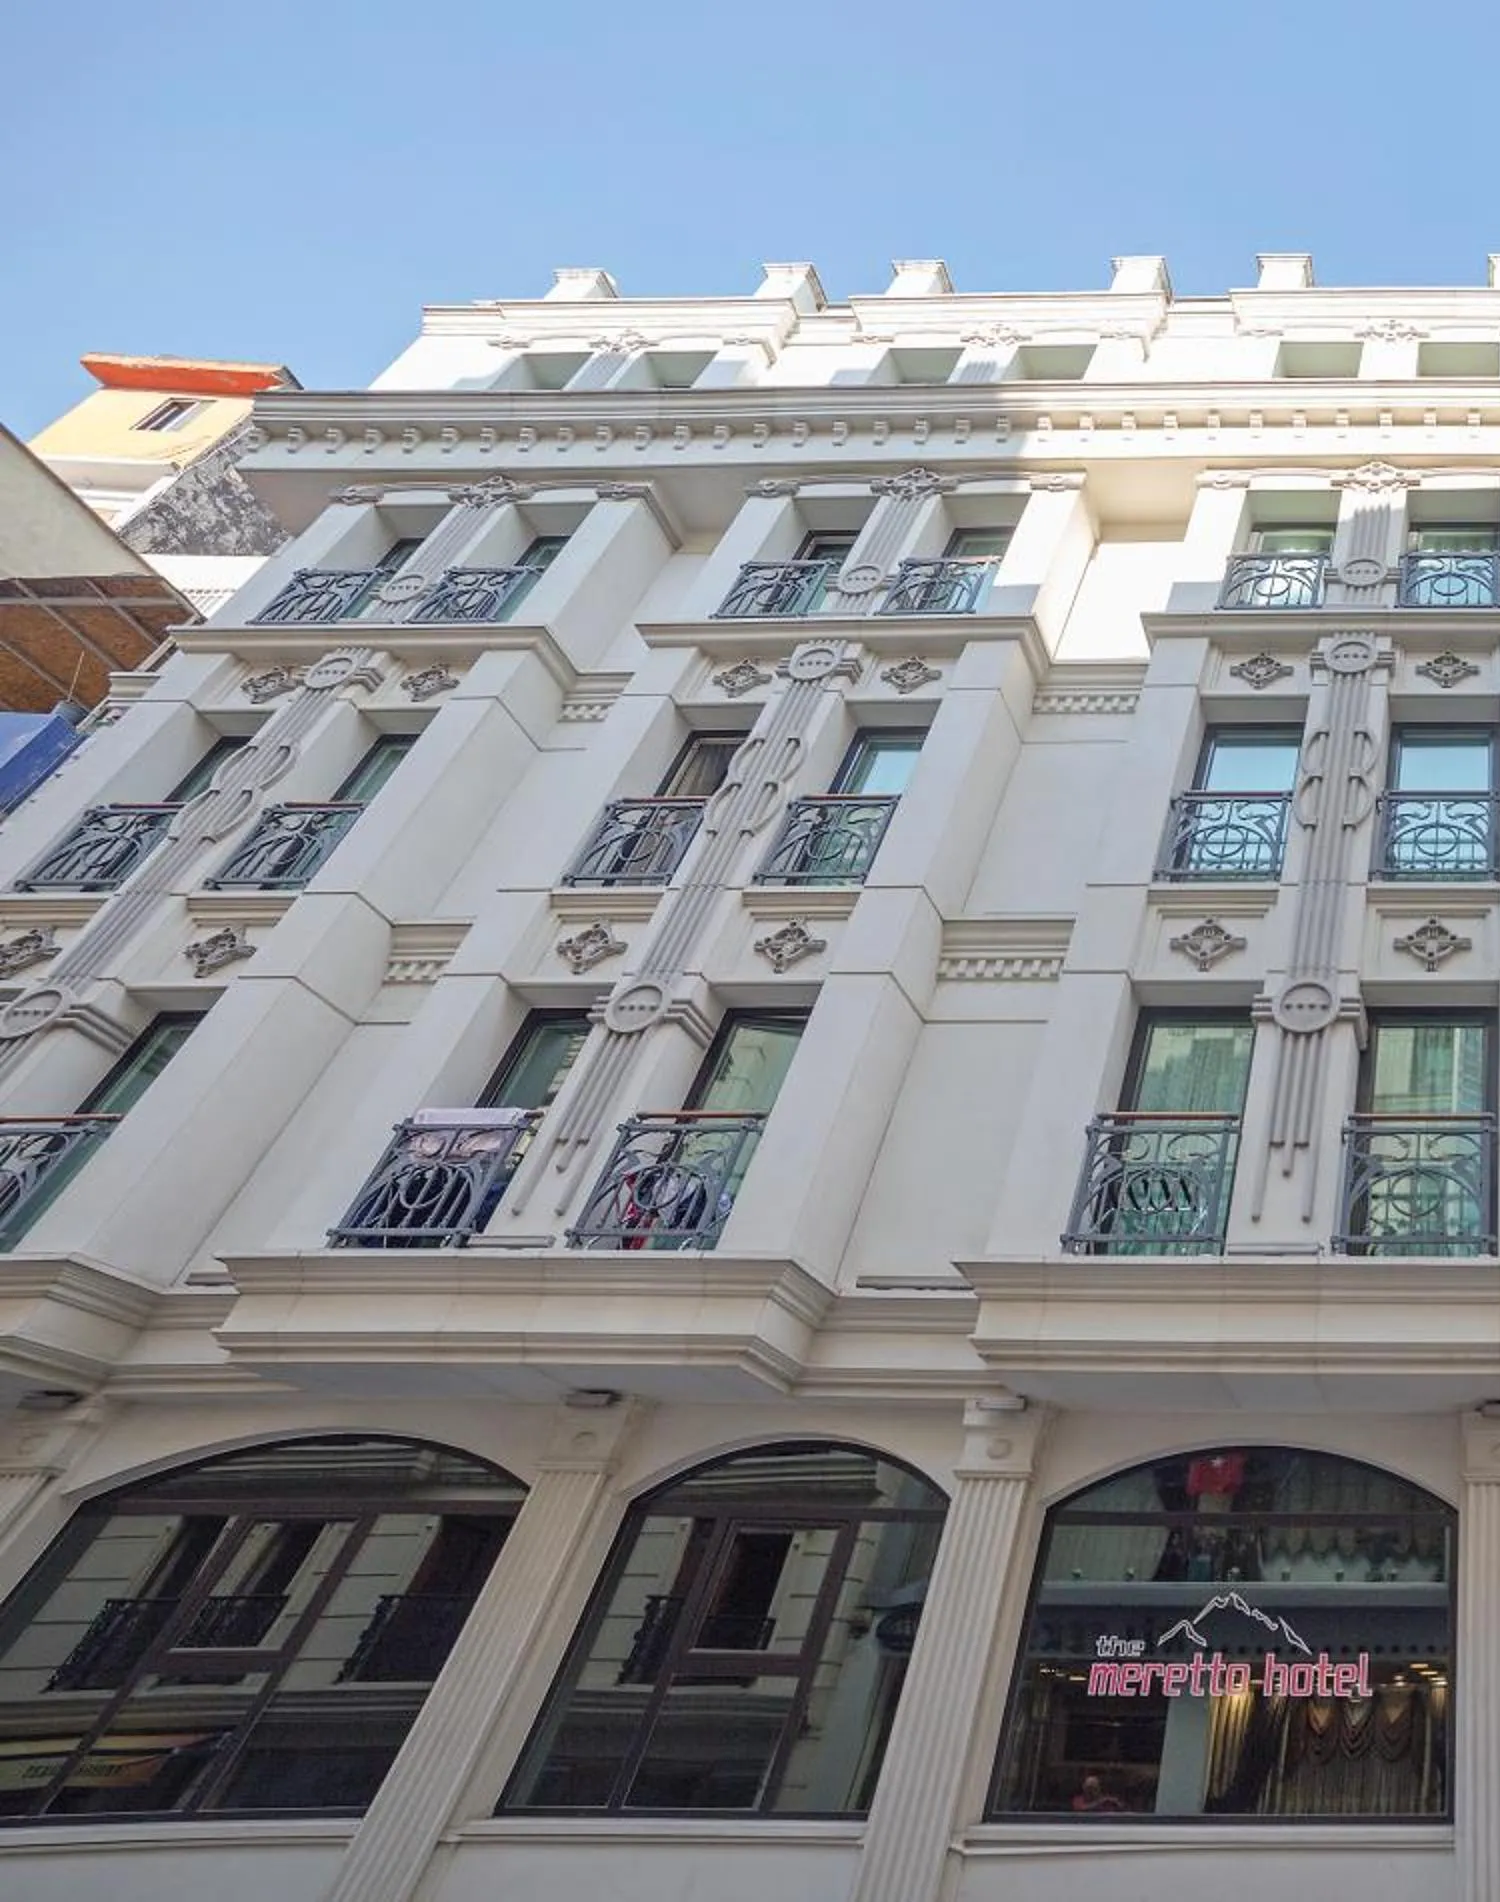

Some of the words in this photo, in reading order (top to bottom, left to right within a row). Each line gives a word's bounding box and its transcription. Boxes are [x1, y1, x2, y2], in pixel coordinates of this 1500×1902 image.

[1096, 1635, 1145, 1657] the
[1088, 1652, 1251, 1697] meretto
[1263, 1652, 1373, 1697] hotel
